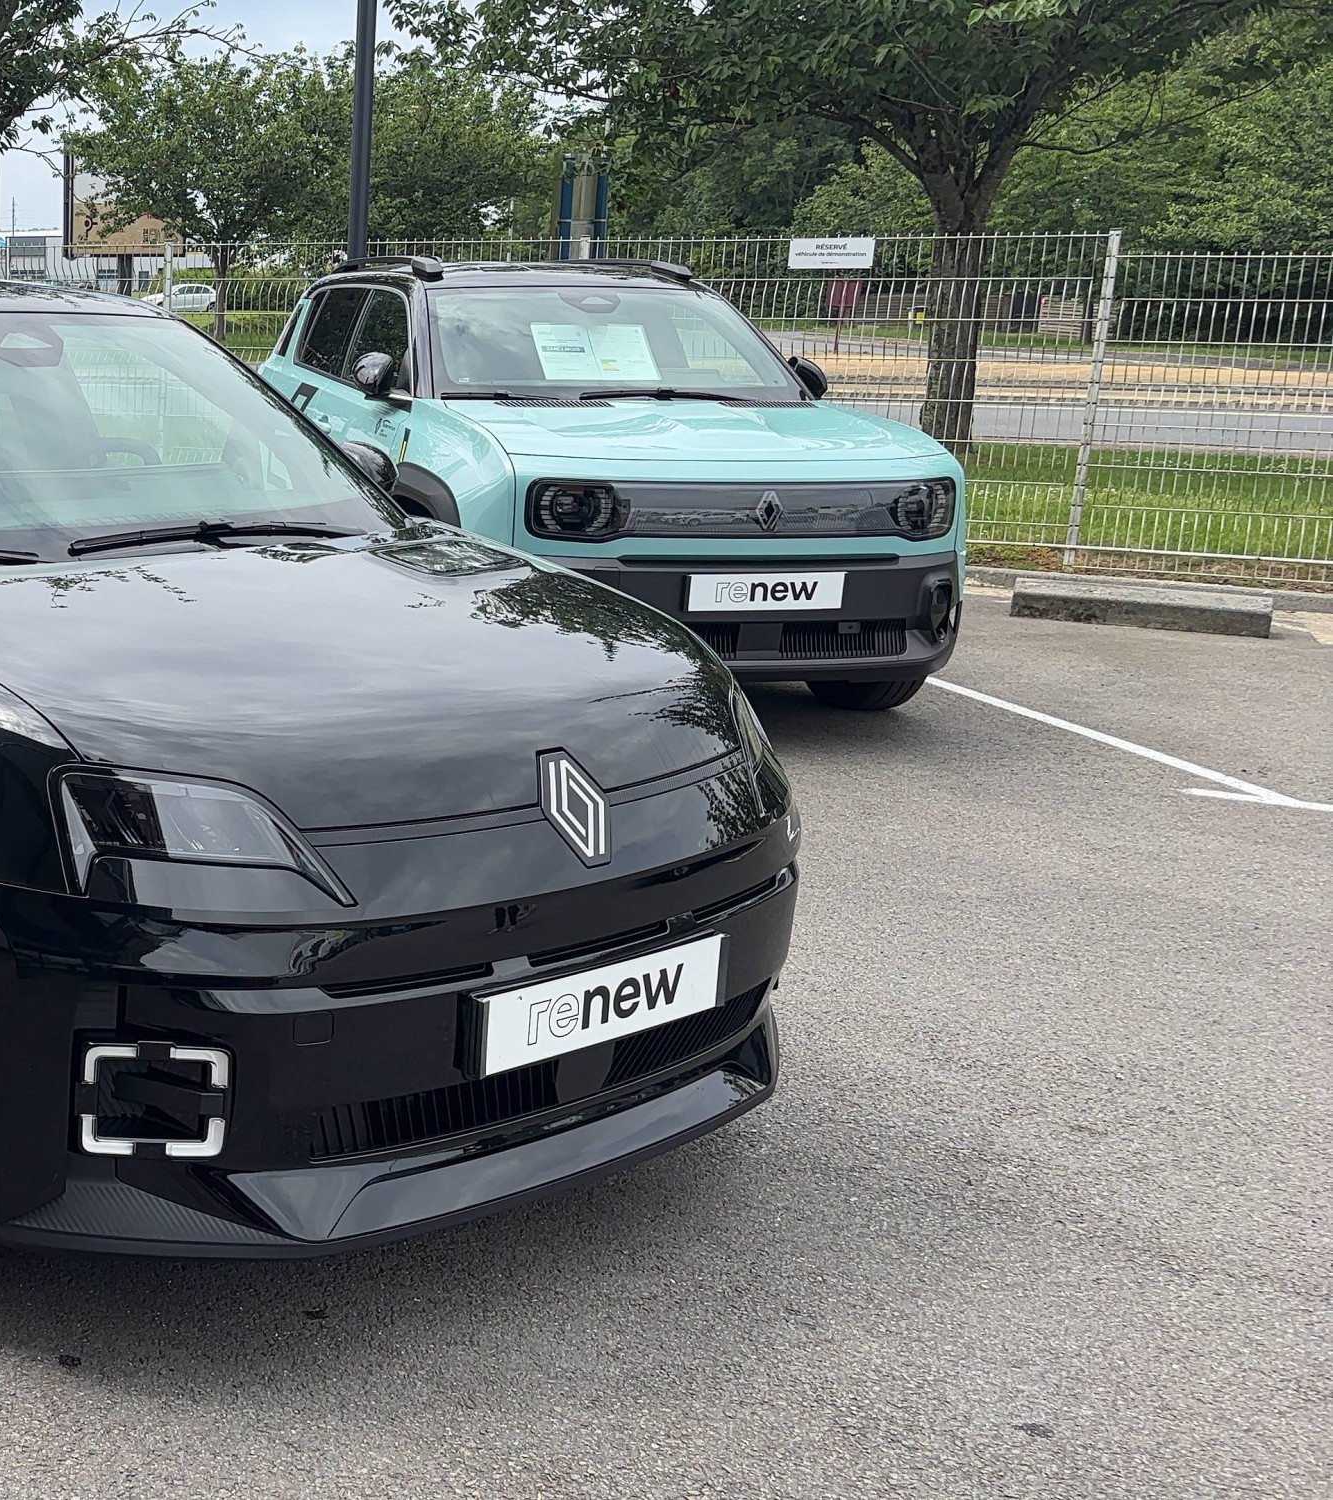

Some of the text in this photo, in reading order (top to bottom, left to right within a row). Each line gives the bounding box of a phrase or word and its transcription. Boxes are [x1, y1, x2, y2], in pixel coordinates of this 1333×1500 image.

[815, 243, 848, 251] RÉSERVÉ
[715, 581, 819, 603] renew
[527, 963, 684, 1046] renew
